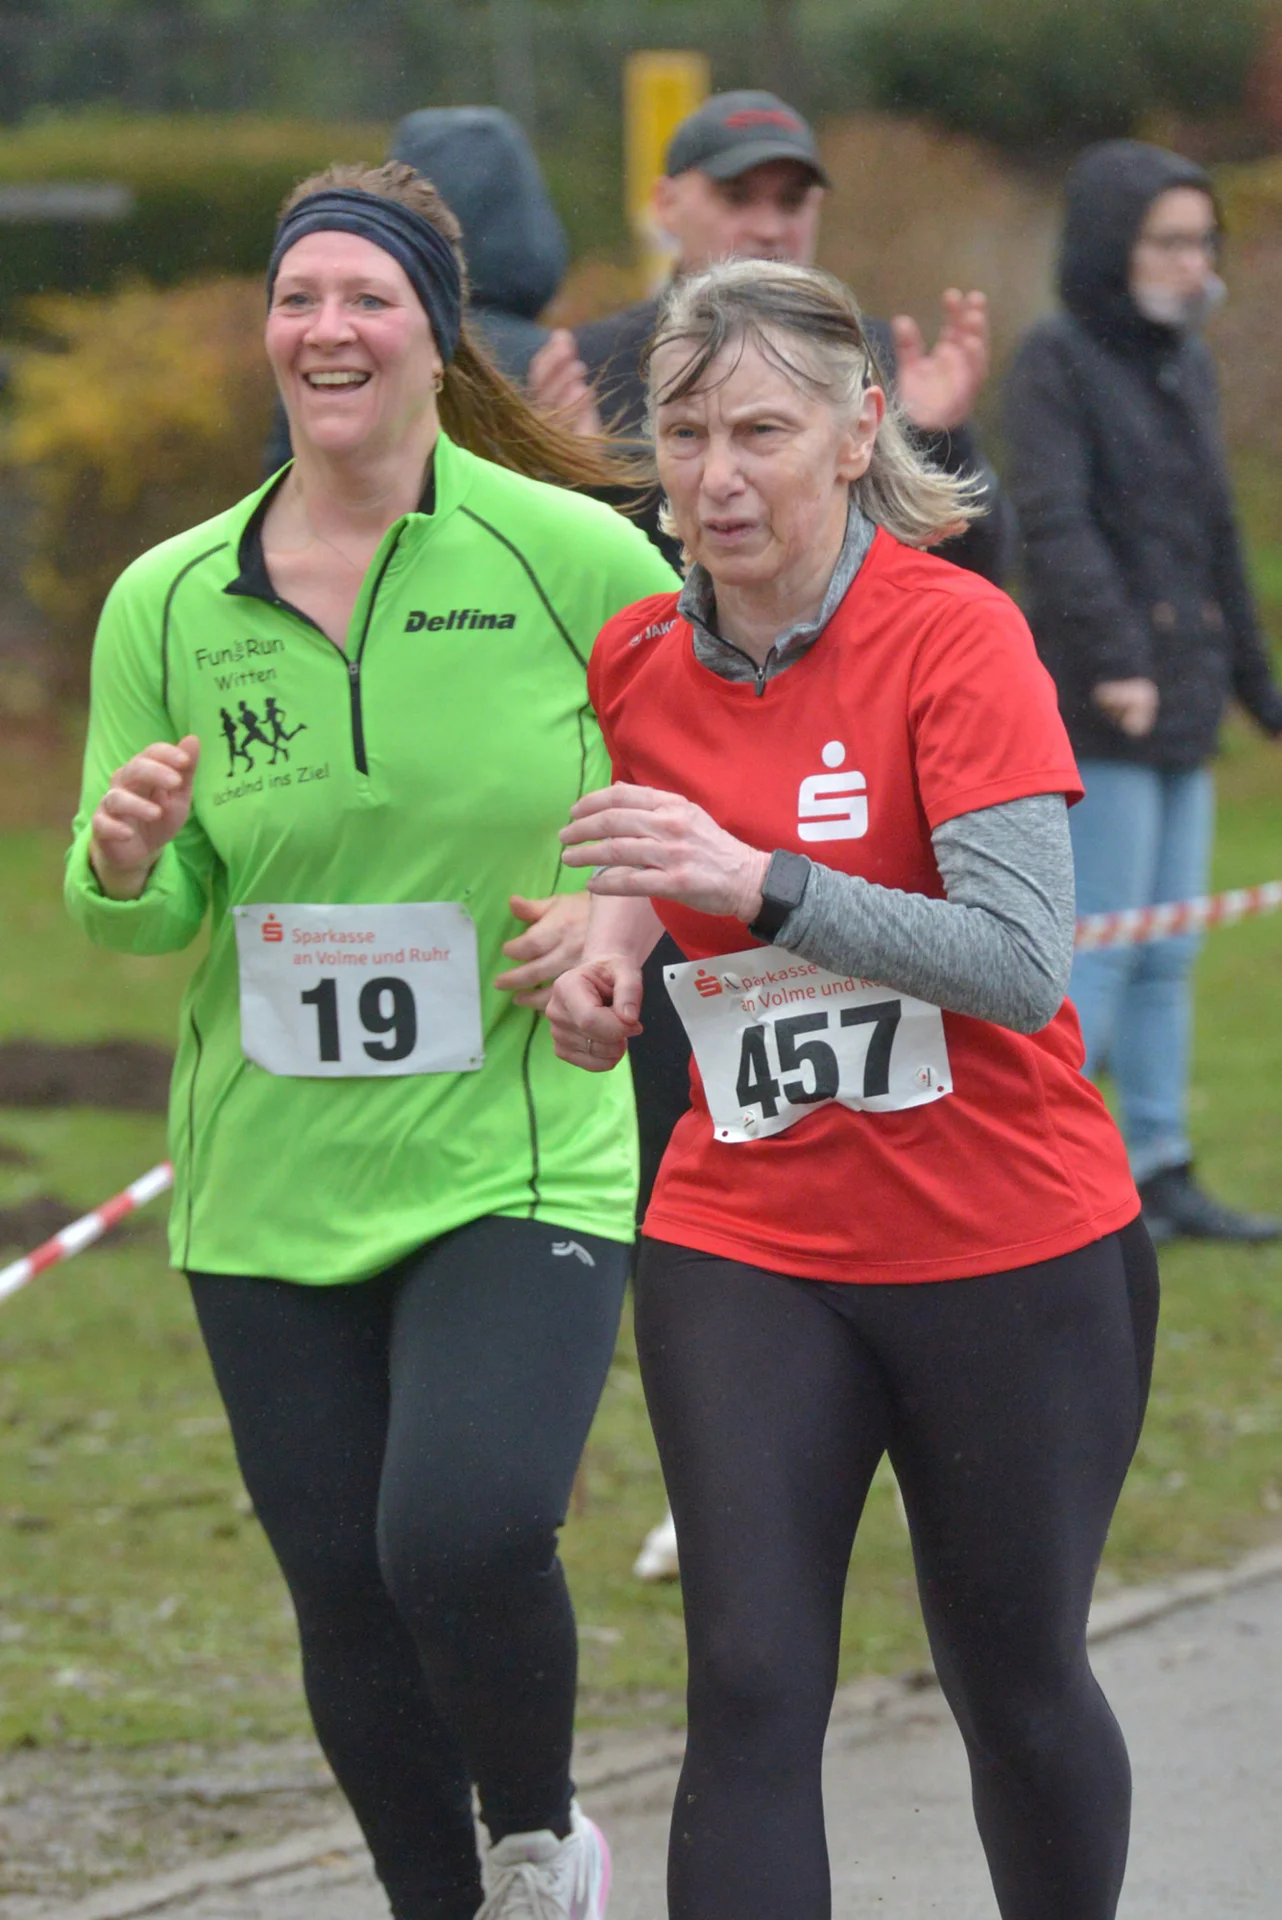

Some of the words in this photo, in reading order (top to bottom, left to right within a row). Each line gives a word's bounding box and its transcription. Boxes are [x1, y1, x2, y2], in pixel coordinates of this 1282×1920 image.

[404, 609, 517, 633] Delfina
[195, 647, 233, 671] Fun
[246, 639, 285, 658] Run
[214, 668, 277, 691] Witten
[268, 773, 292, 788] ins
[296, 761, 330, 783] Ziel
[291, 928, 376, 945] Sparkasse
[293, 953, 312, 965] an
[316, 950, 367, 965] Volme
[372, 947, 405, 965] und
[409, 947, 450, 963] Ruhr
[725, 963, 818, 991] parkasse
[758, 987, 816, 1008] Volme
[821, 975, 855, 996] und
[301, 976, 418, 1062] 19
[736, 998, 902, 1119] 457
